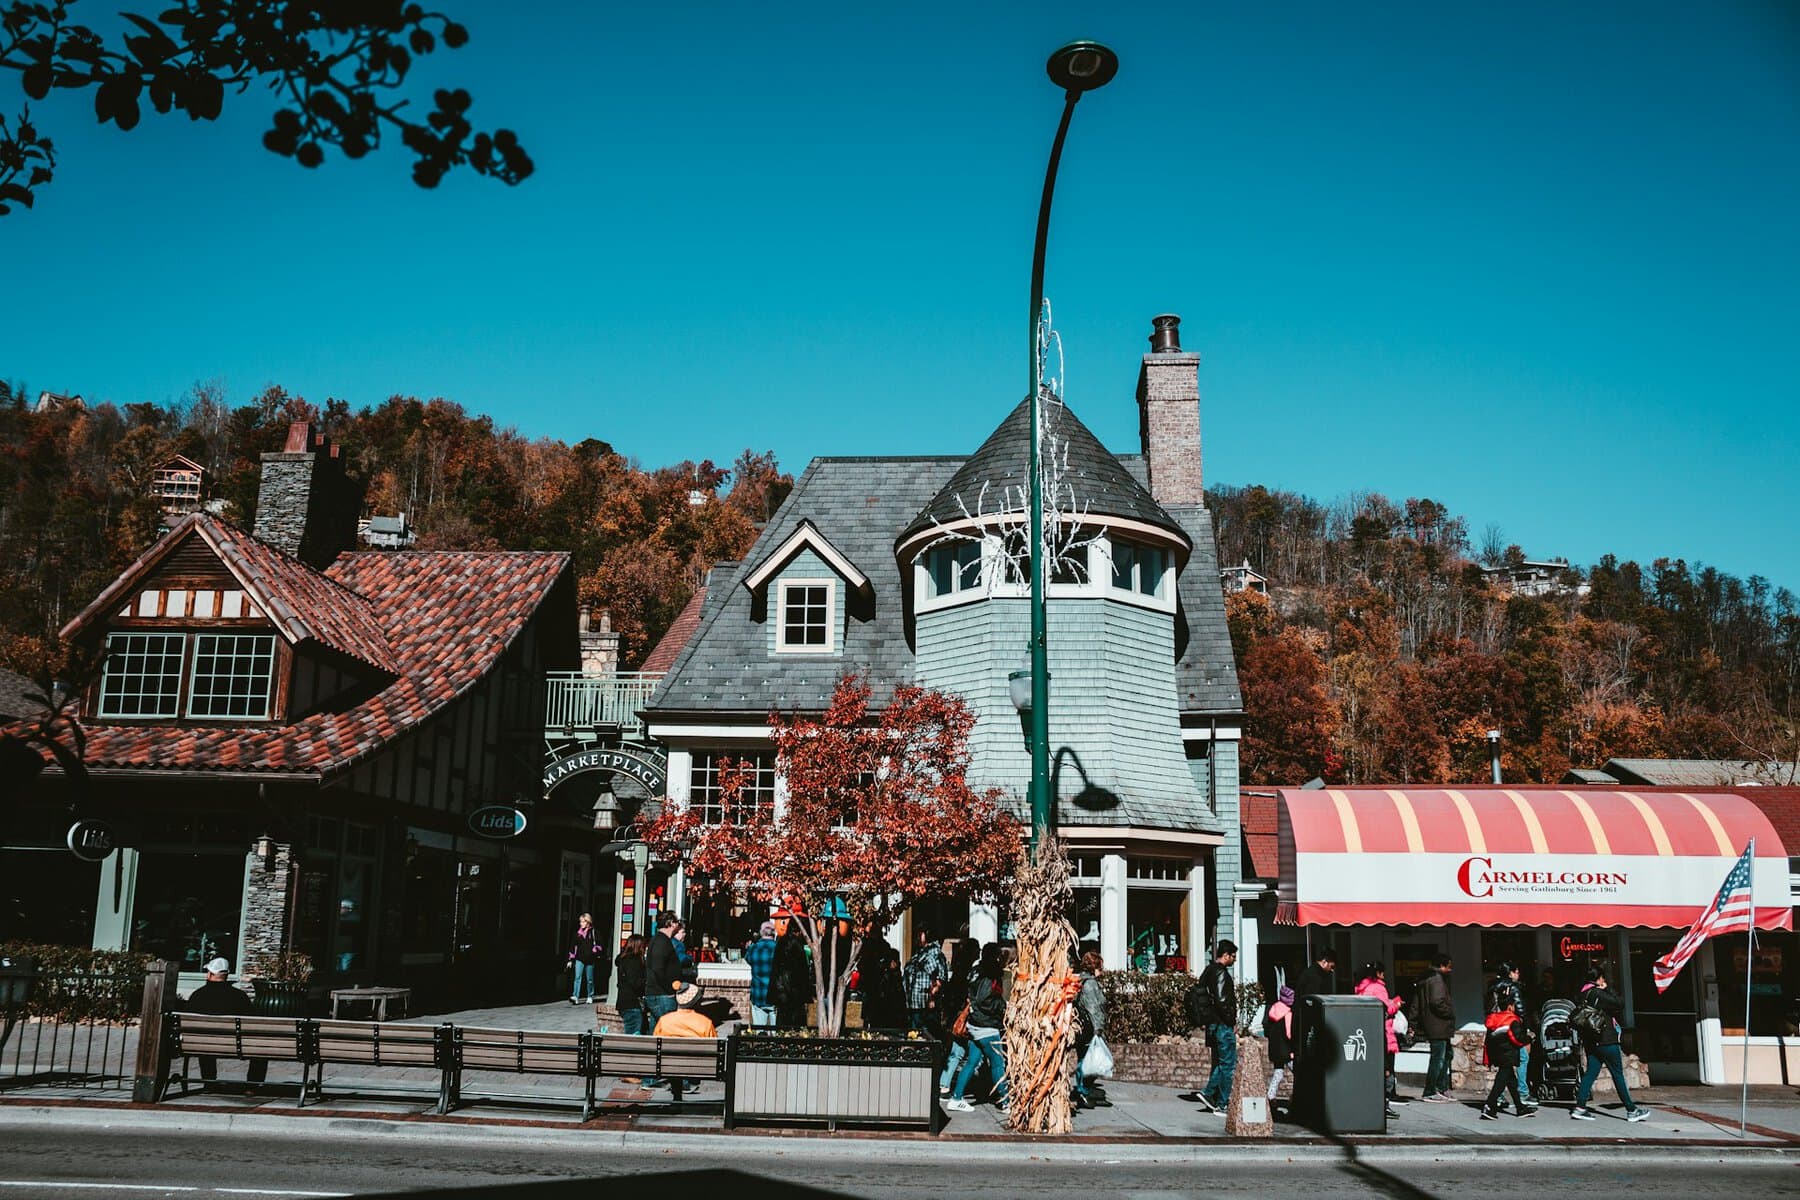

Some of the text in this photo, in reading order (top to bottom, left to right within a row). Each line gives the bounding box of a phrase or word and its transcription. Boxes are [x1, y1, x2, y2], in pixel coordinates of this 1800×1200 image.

[542, 755, 660, 789] MARKETPLACE
[480, 814, 513, 829] Lids
[1457, 857, 1627, 897] CARMELCORN
[1498, 885, 1529, 893] Serving
[1531, 885, 1574, 894] Gatlinburg
